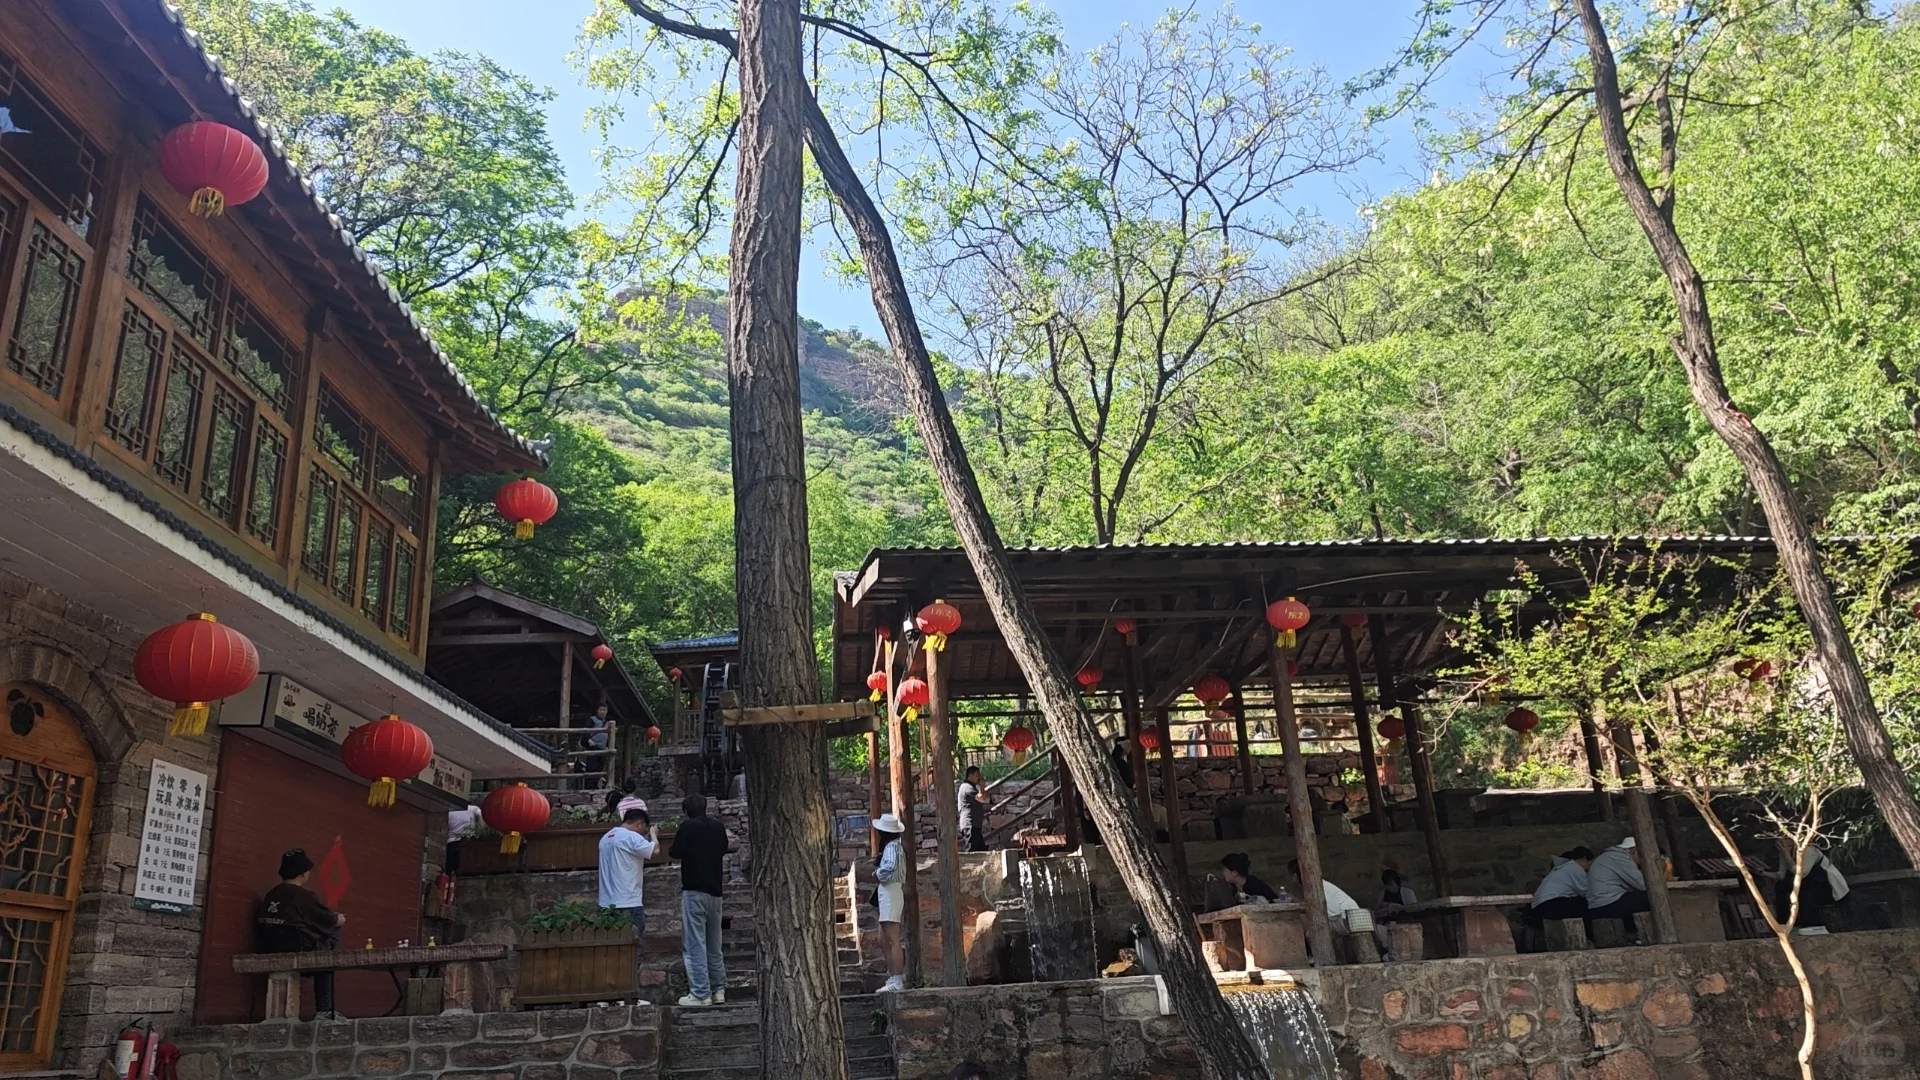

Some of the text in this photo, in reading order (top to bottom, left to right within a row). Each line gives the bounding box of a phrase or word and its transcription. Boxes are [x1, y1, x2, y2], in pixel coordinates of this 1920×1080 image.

[315, 701, 332, 716] 一起
[302, 707, 340, 738] 喝奶茶
[158, 773, 175, 789] 冷饮
[156, 790, 199, 812] 玩具 冰淇淋
